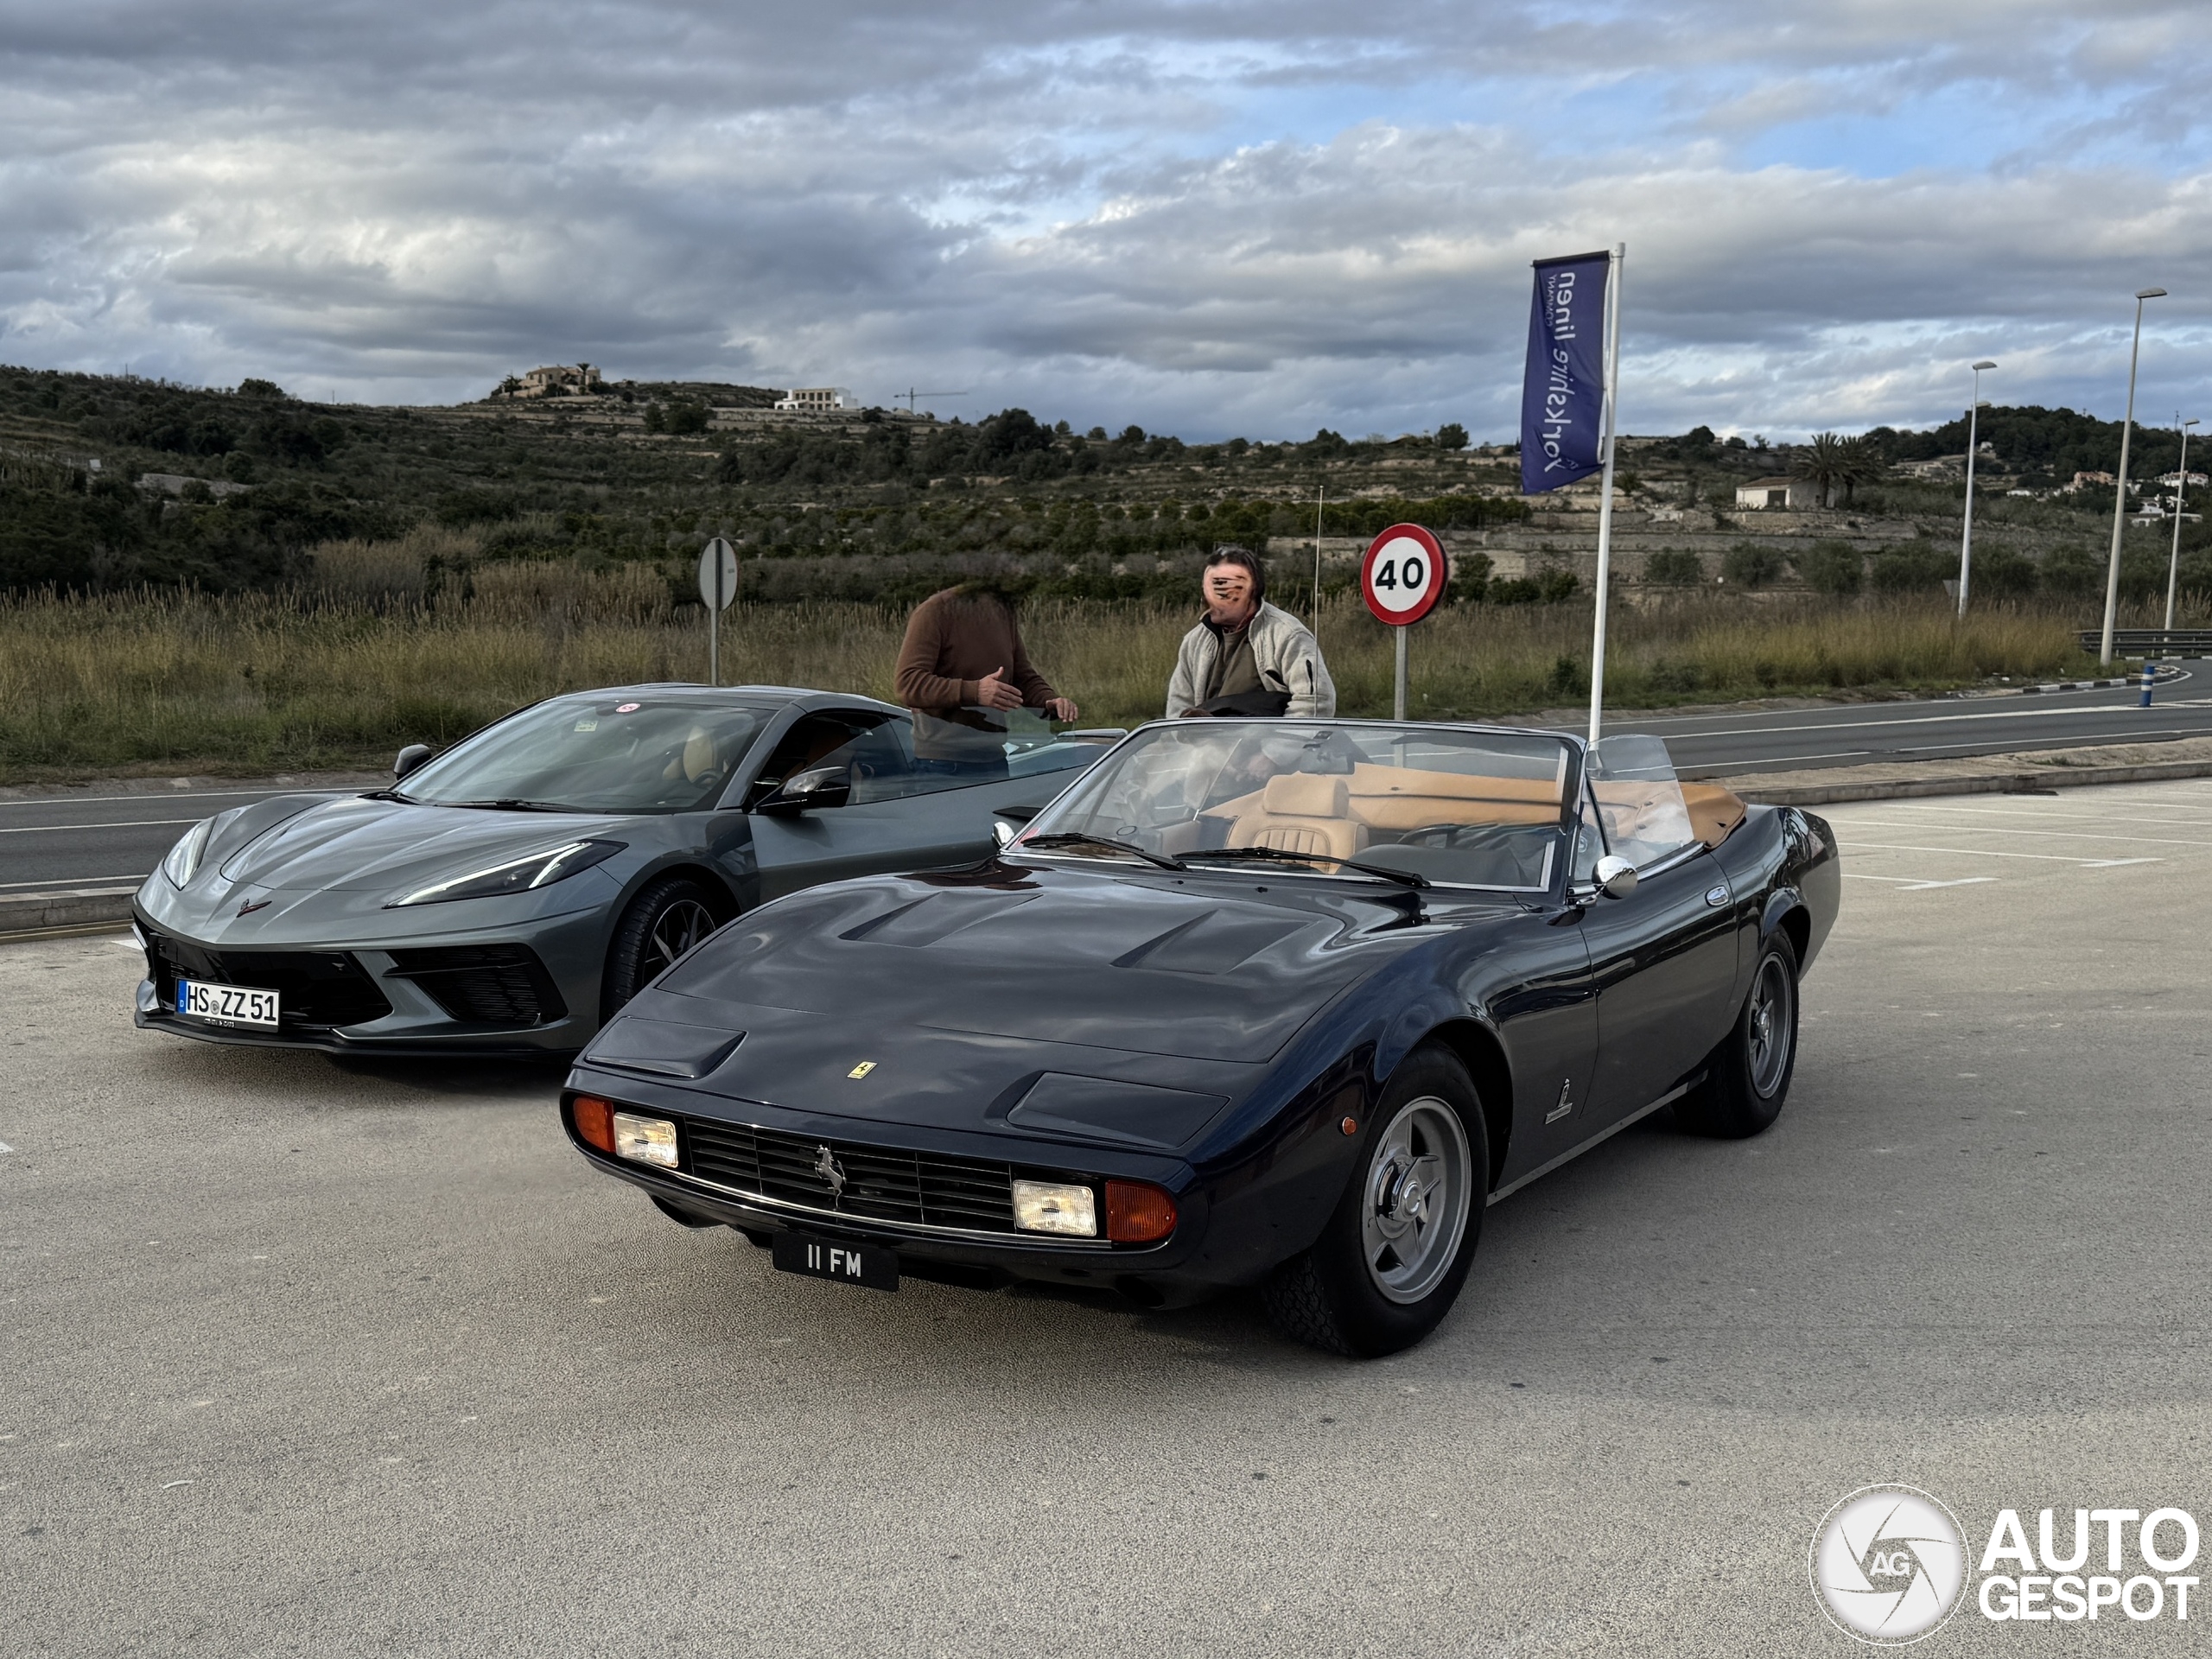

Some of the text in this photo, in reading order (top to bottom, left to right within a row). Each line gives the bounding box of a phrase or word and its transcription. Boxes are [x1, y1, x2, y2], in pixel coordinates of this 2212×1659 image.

[1375, 556, 1424, 590] 40
[179, 999, 184, 1007] D
[187, 984, 276, 1021] HS ZZ 51
[808, 1243, 861, 1277] 11 FM
